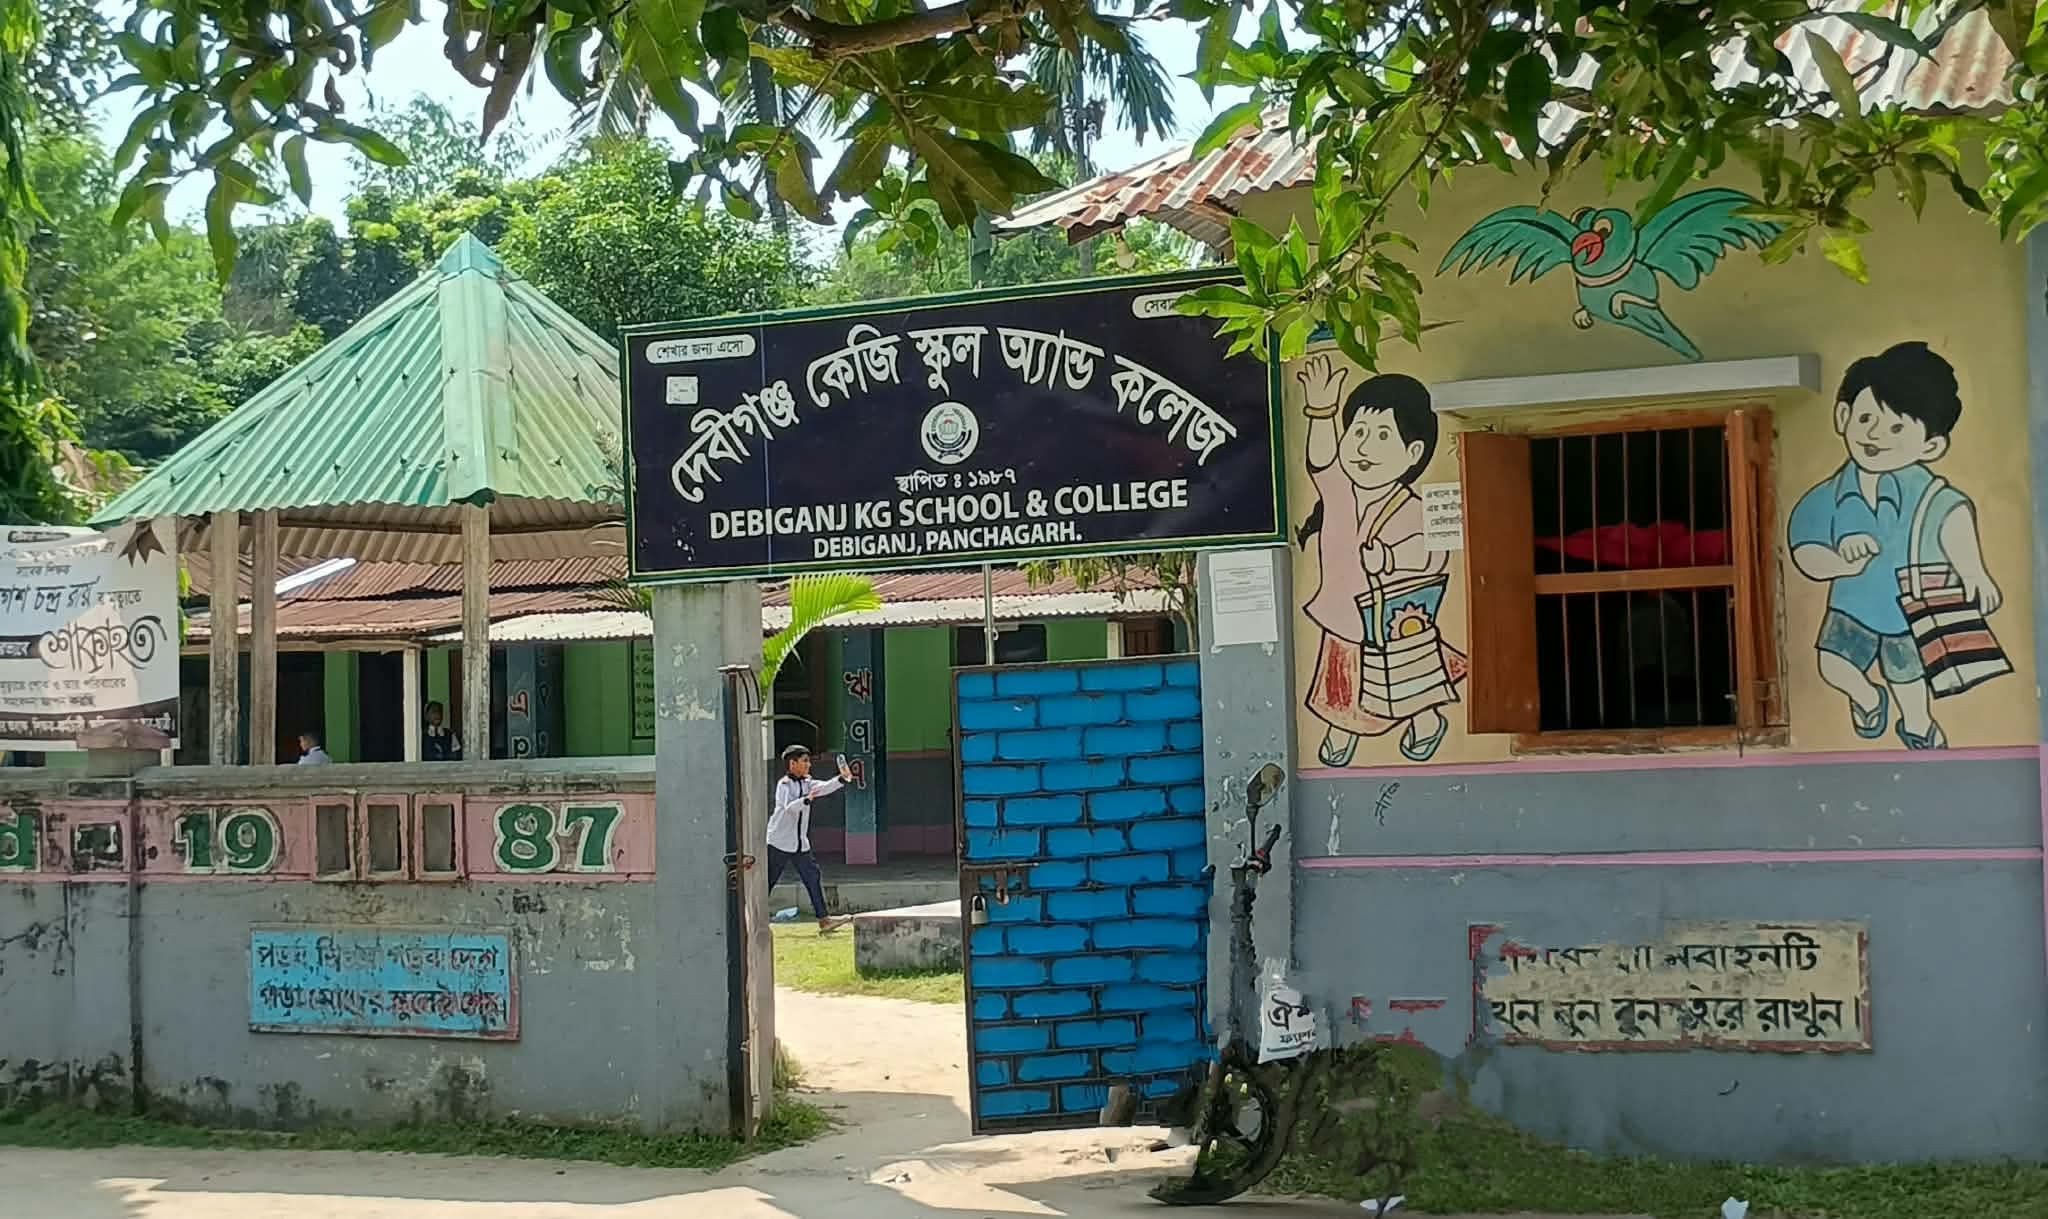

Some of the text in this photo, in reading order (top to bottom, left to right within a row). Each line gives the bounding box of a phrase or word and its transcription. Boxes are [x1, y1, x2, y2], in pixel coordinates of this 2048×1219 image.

[671, 379, 800, 503] দেবীগঞ্জ
[806, 323, 901, 408] কেজি
[907, 325, 989, 397] স্কুল
[1110, 354, 1237, 466] কলেজ
[709, 479, 1188, 540] DEBIGANJ KG SCHOOL & COLLEGE
[895, 469, 949, 496] স্থাপিত
[968, 467, 1017, 487] ১৯৮৭
[813, 520, 1083, 559] DEBIGANJ, PANCHAGARH.
[174, 804, 280, 874] 19
[492, 801, 624, 874] 87
